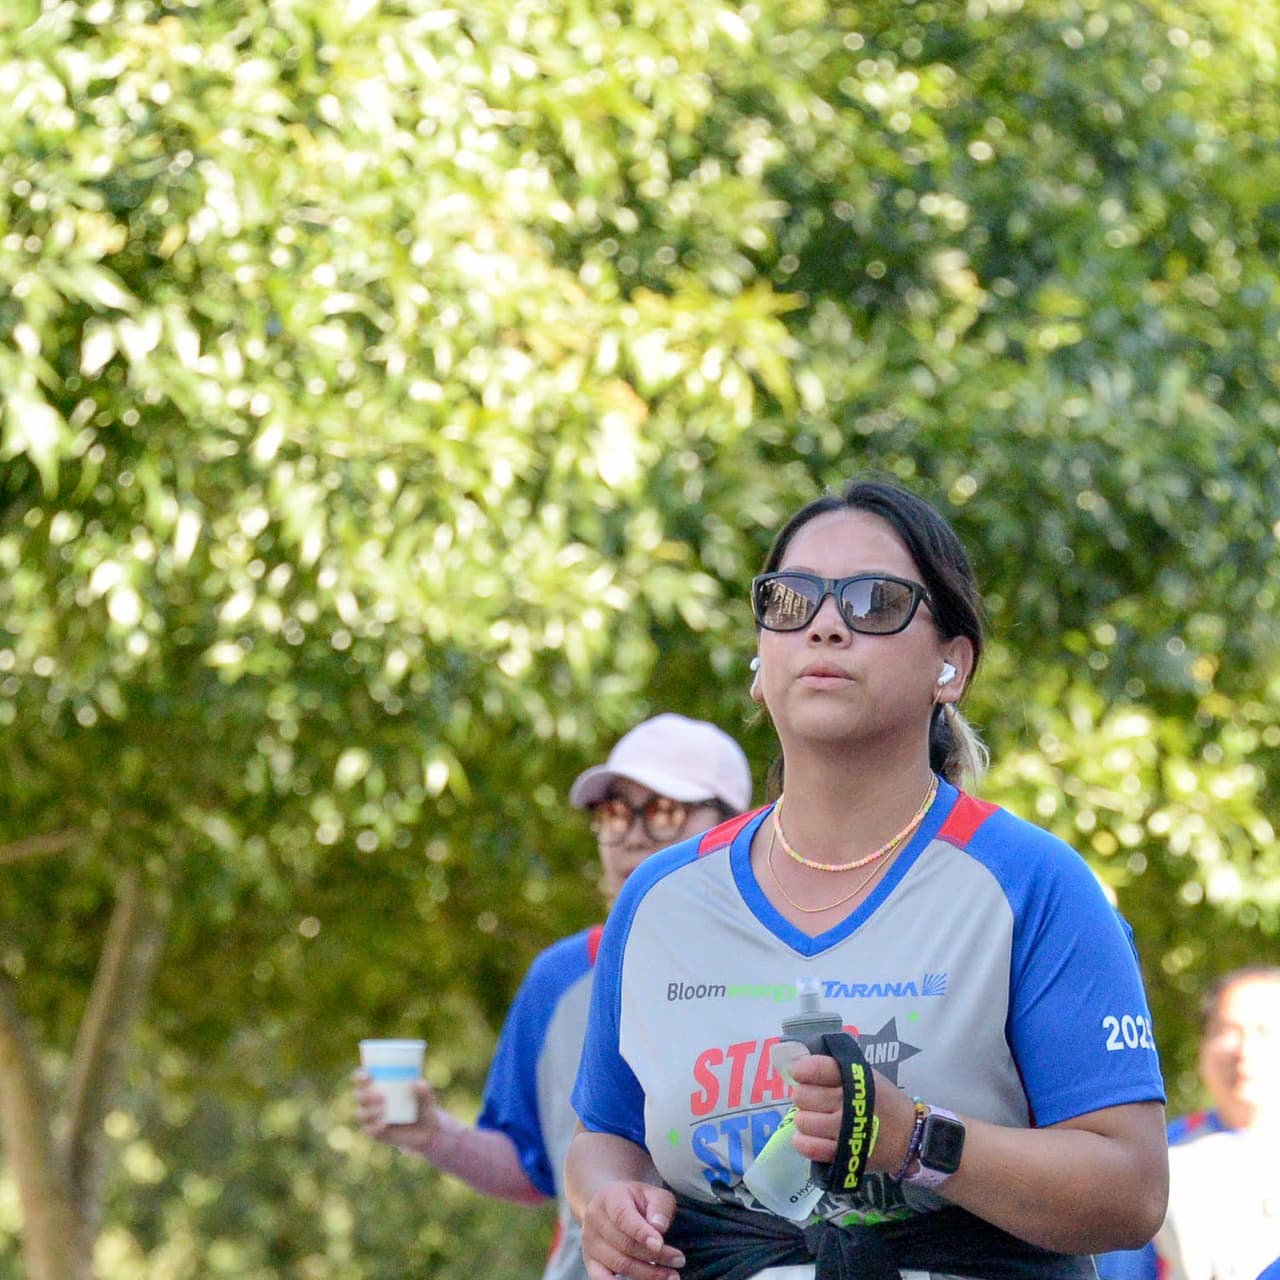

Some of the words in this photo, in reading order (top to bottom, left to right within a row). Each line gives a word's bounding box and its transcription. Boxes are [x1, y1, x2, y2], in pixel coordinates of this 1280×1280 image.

[822, 980, 919, 998] TARANA
[864, 1041, 900, 1065] AND
[843, 1062, 867, 1189] amphipod
